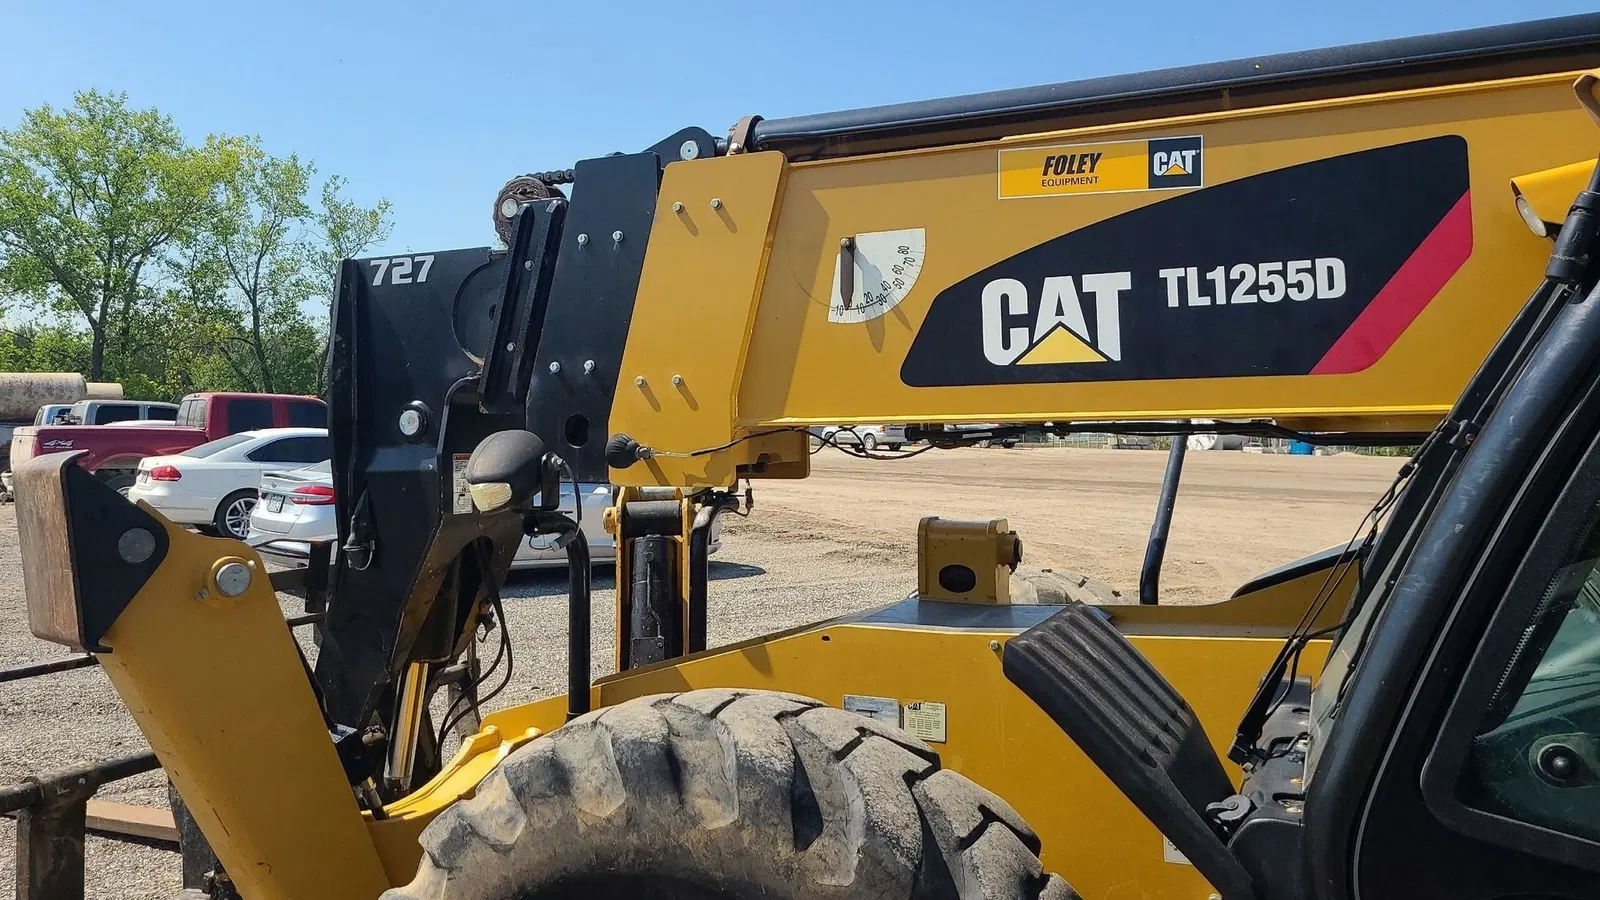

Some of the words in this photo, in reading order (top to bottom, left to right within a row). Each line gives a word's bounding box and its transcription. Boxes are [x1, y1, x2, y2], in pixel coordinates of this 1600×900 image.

[1042, 152, 1102, 177] FOLEY
[1153, 149, 1196, 177] CAT
[1041, 176, 1100, 187] EQUIPMENT
[898, 246, 909, 254] 80
[903, 257, 915, 267] 70
[370, 254, 435, 286] 727
[892, 265, 904, 275] 60
[881, 281, 891, 291] 40
[893, 278, 904, 289] 50
[863, 291, 874, 304] 20
[876, 294, 887, 305] 30
[856, 302, 866, 315] 10
[981, 271, 1132, 366] CAT
[1159, 257, 1347, 308] TL1255D
